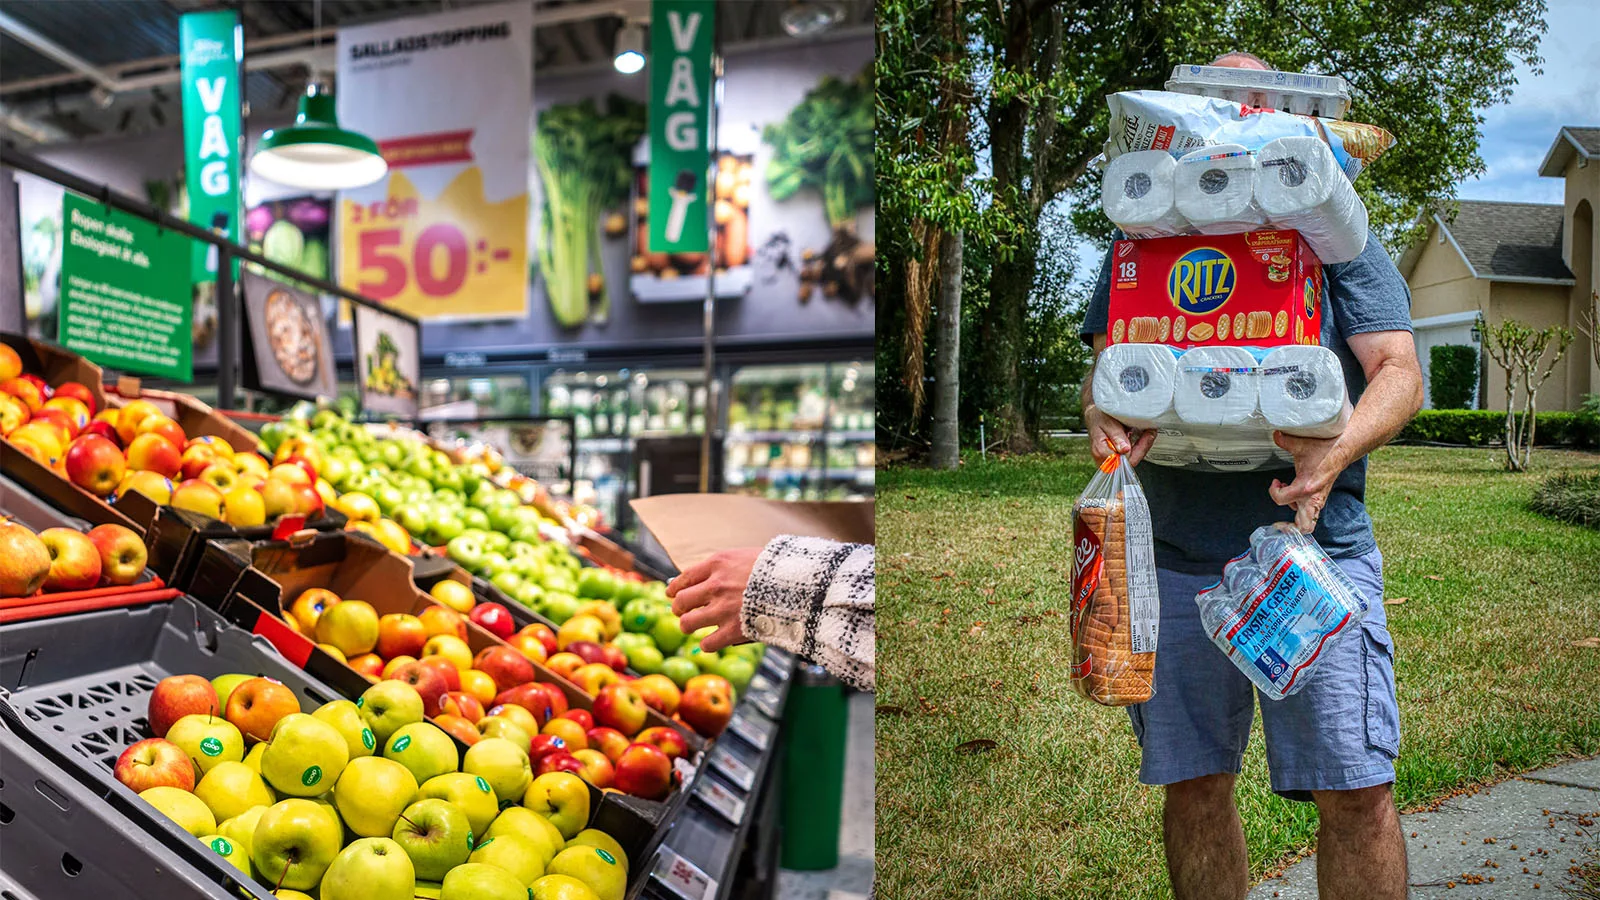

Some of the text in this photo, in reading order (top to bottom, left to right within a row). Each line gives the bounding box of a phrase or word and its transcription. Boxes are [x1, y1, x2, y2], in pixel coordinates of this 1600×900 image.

[1119, 262, 1136, 278] 18
[1173, 258, 1232, 307] RITZ
[1237, 610, 1270, 646] CRYSTAL
[1267, 569, 1300, 610] GEYSER
[1260, 597, 1293, 635] NATURAL
[1271, 609, 1292, 631] SPRING
[1288, 587, 1308, 609] WATER
[1261, 654, 1272, 665] 6
[204, 742, 220, 750] coop
[307, 769, 317, 784] coop
